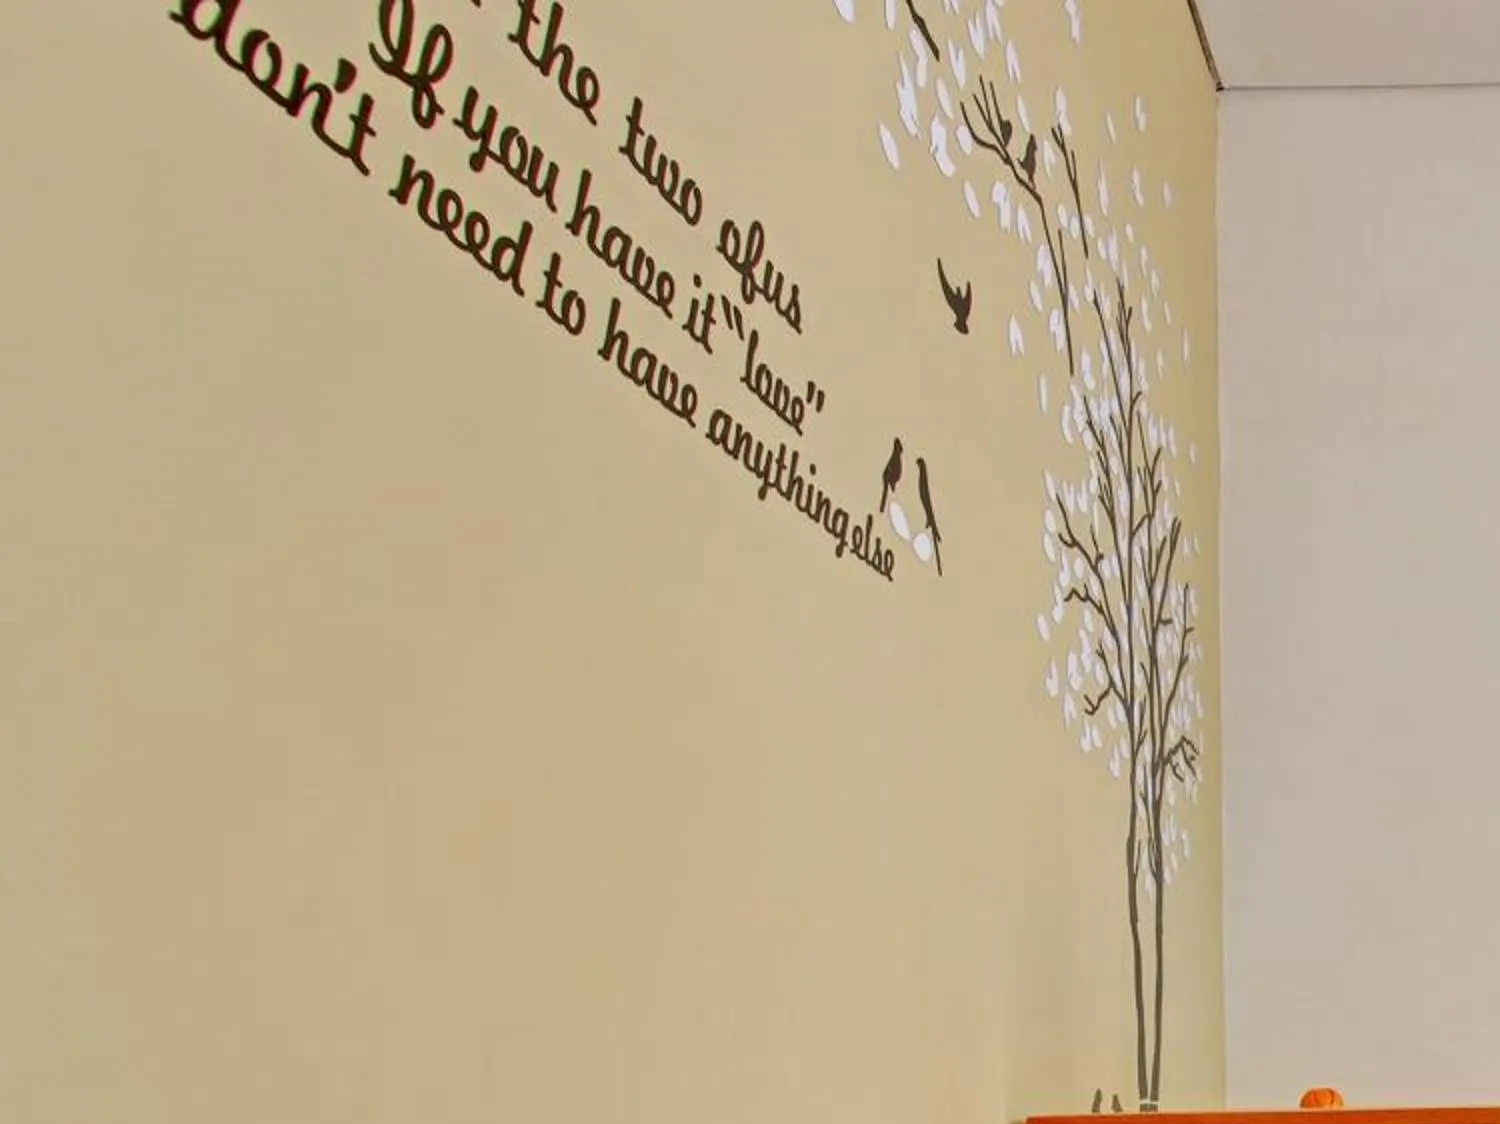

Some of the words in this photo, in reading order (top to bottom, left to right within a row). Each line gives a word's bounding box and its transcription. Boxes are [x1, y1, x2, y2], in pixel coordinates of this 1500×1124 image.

[169, 0, 376, 176] don't
[388, 154, 533, 297] need
[535, 252, 586, 336] to
[597, 298, 697, 428] have
[368, 0, 453, 129] If
[452, 86, 559, 213] you
[565, 169, 675, 319] have
[508, 0, 599, 126] the
[619, 96, 702, 226] two
